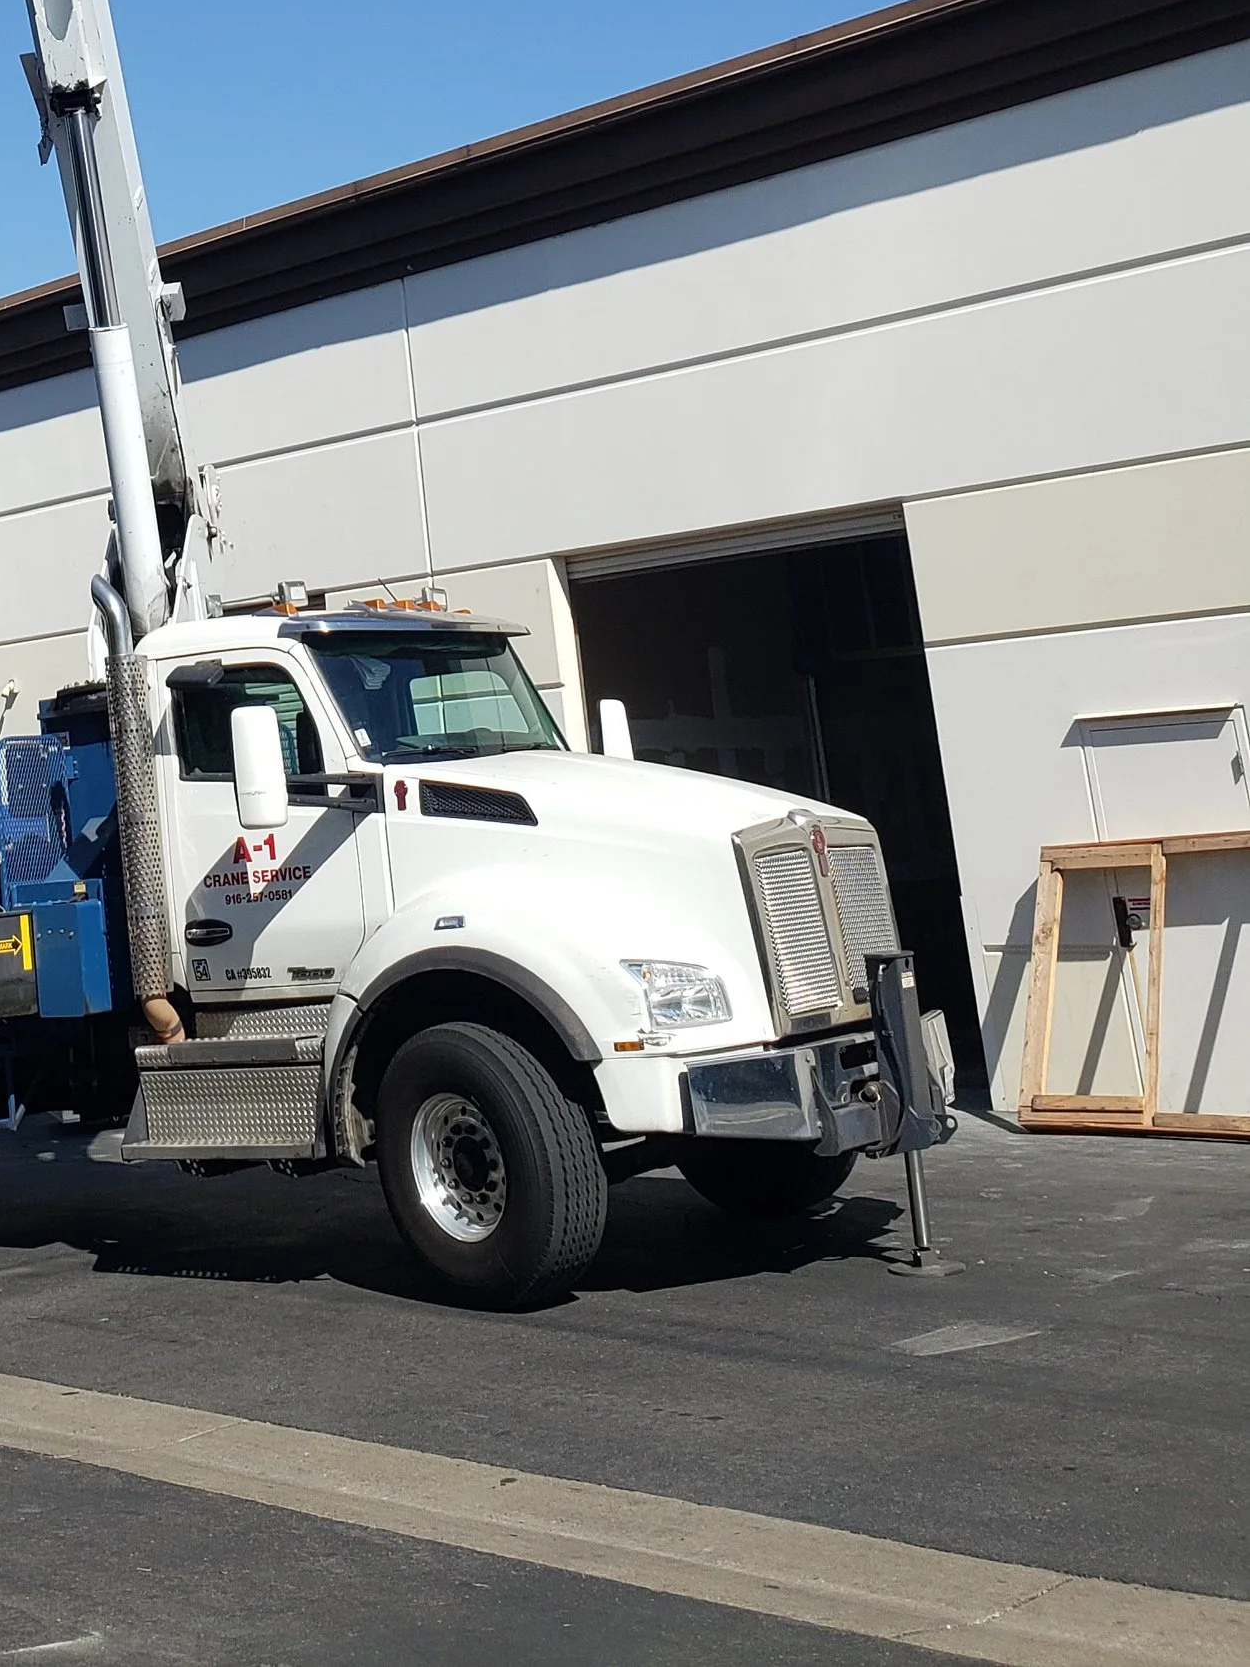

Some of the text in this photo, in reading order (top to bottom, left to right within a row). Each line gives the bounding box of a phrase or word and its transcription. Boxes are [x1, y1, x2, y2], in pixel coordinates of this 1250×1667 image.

[233, 833, 277, 864] A-1
[204, 866, 312, 888] CRANE SERVICE
[225, 889, 293, 905] 916-257-0581
[225, 969, 237, 981] CA
